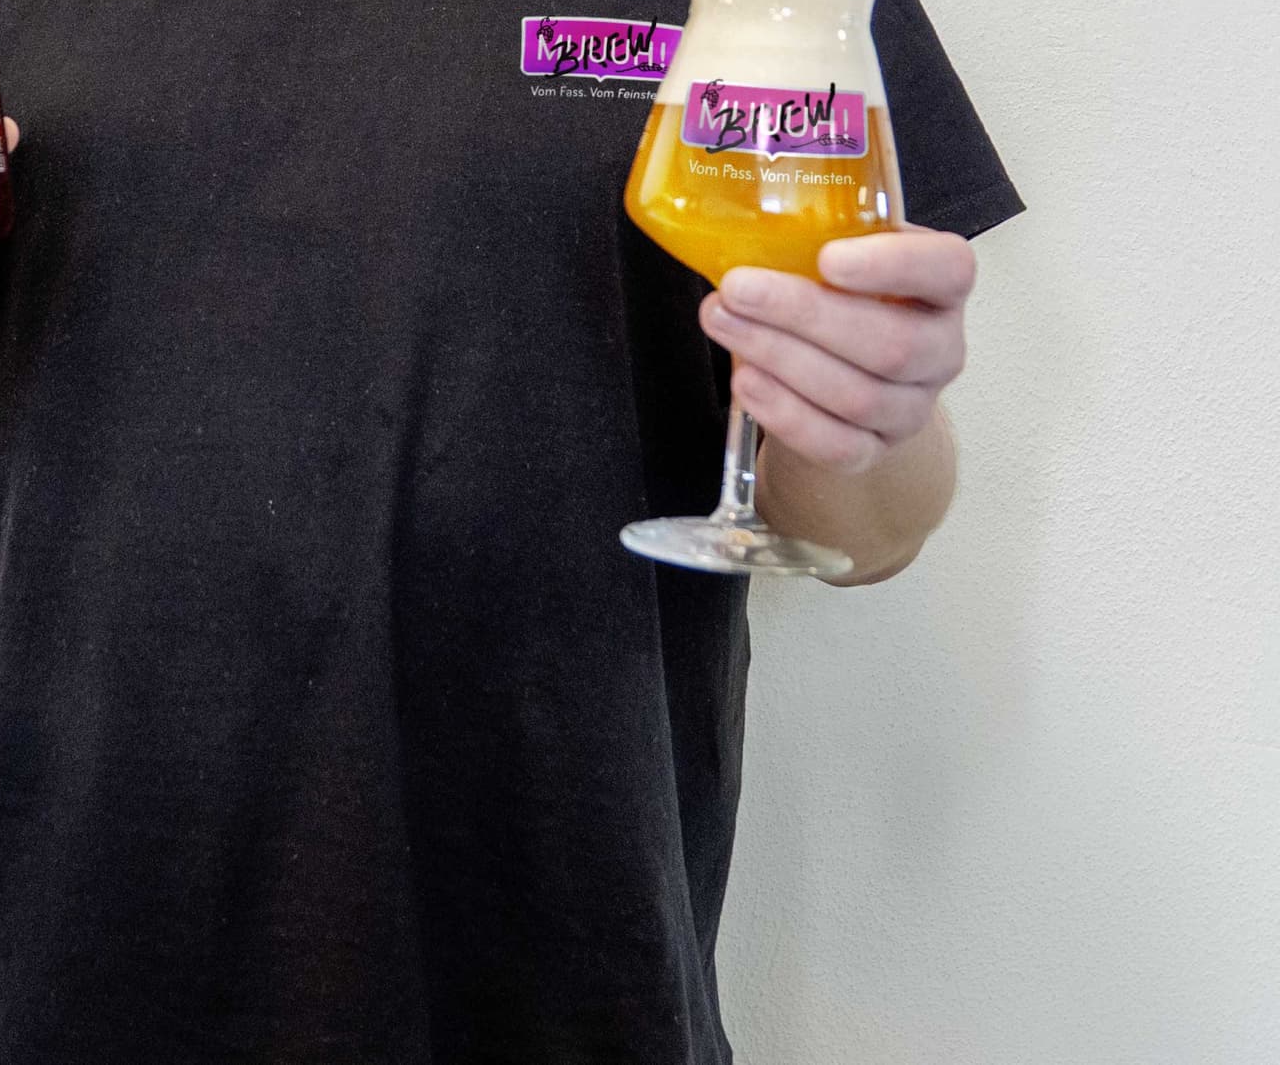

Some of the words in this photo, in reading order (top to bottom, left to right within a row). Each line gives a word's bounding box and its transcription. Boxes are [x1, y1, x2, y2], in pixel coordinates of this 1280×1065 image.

[530, 85, 556, 97] Vom
[559, 86, 587, 98] Fass.
[590, 87, 614, 99] Vom
[618, 88, 657, 101] Feinste
[688, 158, 718, 177] Vom
[722, 163, 756, 181] Fass.
[760, 166, 790, 184] Vom
[794, 169, 856, 186] Feinsten.
